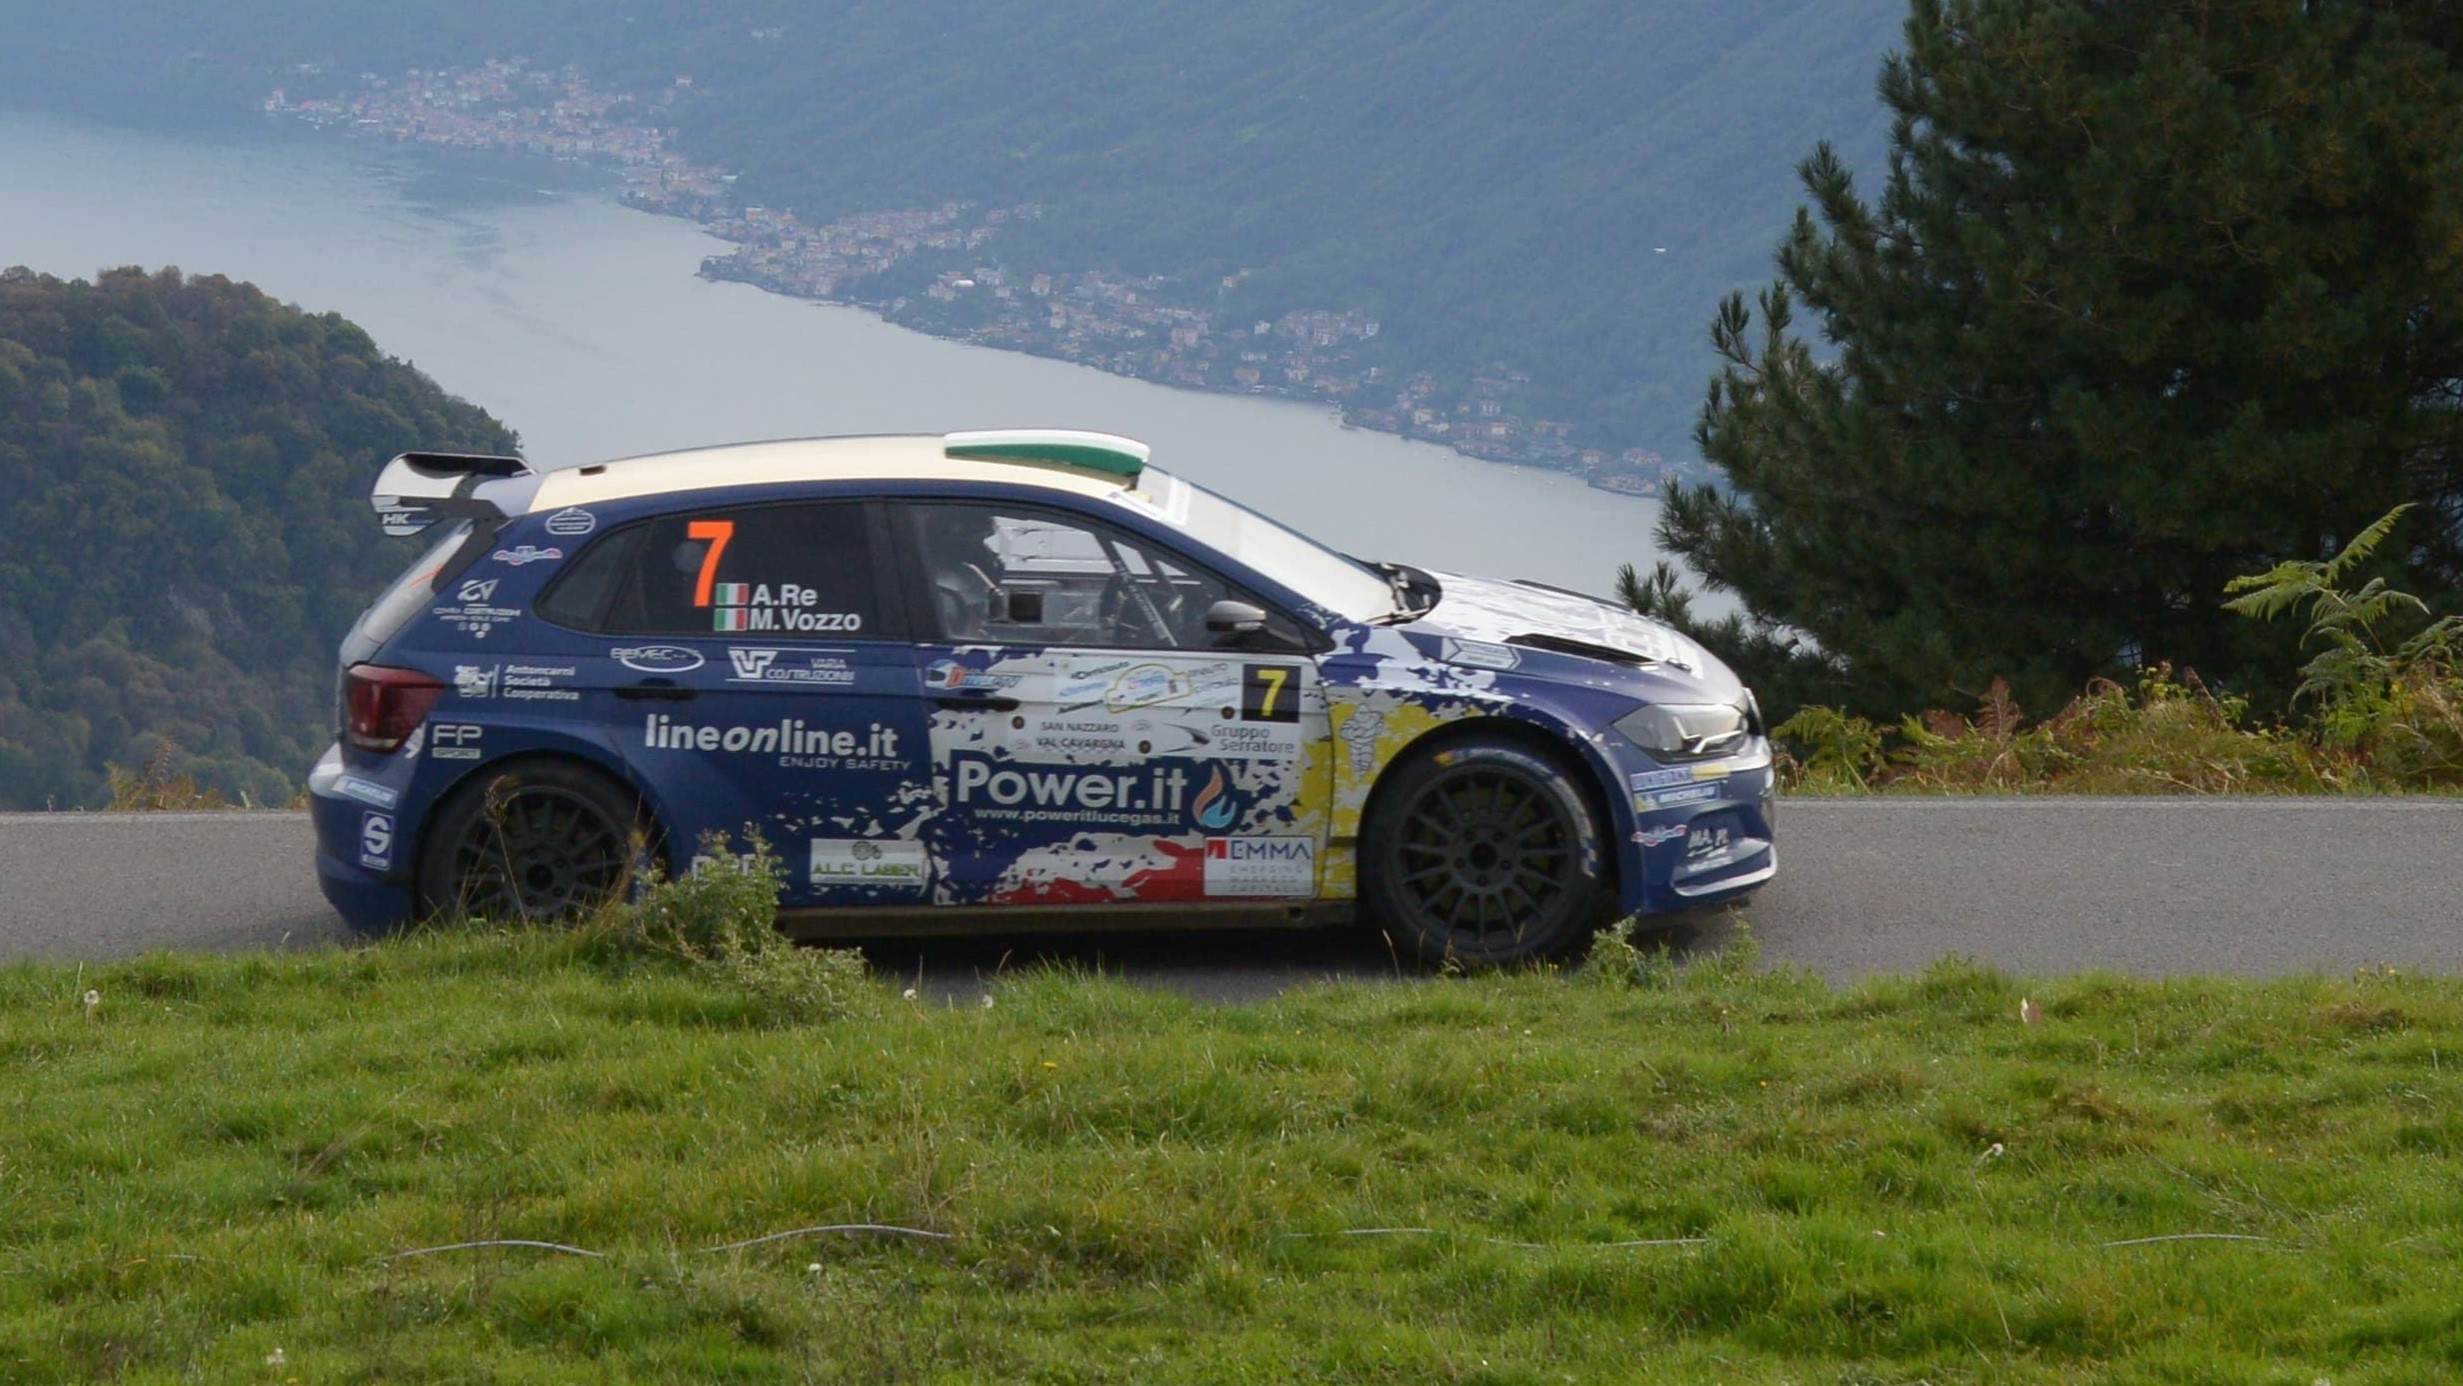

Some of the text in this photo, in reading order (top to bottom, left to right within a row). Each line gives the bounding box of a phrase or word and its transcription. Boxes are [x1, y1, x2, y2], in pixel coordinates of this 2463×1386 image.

[382, 513, 411, 525] HK
[687, 520, 734, 608] 7
[750, 583, 818, 607] A.Re
[749, 608, 862, 632] M.Vozzo
[504, 675, 551, 687] Società
[503, 687, 580, 700] Cooperativa
[1256, 669, 1288, 717] 7
[433, 724, 482, 745] FP
[645, 713, 898, 758] lineonline.it
[1041, 721, 1119, 734] SAN NAZZARO
[1211, 724, 1271, 740] Gruppo
[1037, 738, 1059, 748] VAL
[1220, 738, 1294, 753] Serratore
[779, 757, 911, 771] ENJOY SAFETY
[957, 760, 1188, 810] Power.it
[974, 807, 1180, 826] www.poweritlucegas.it
[1231, 840, 1311, 860] EMMA
